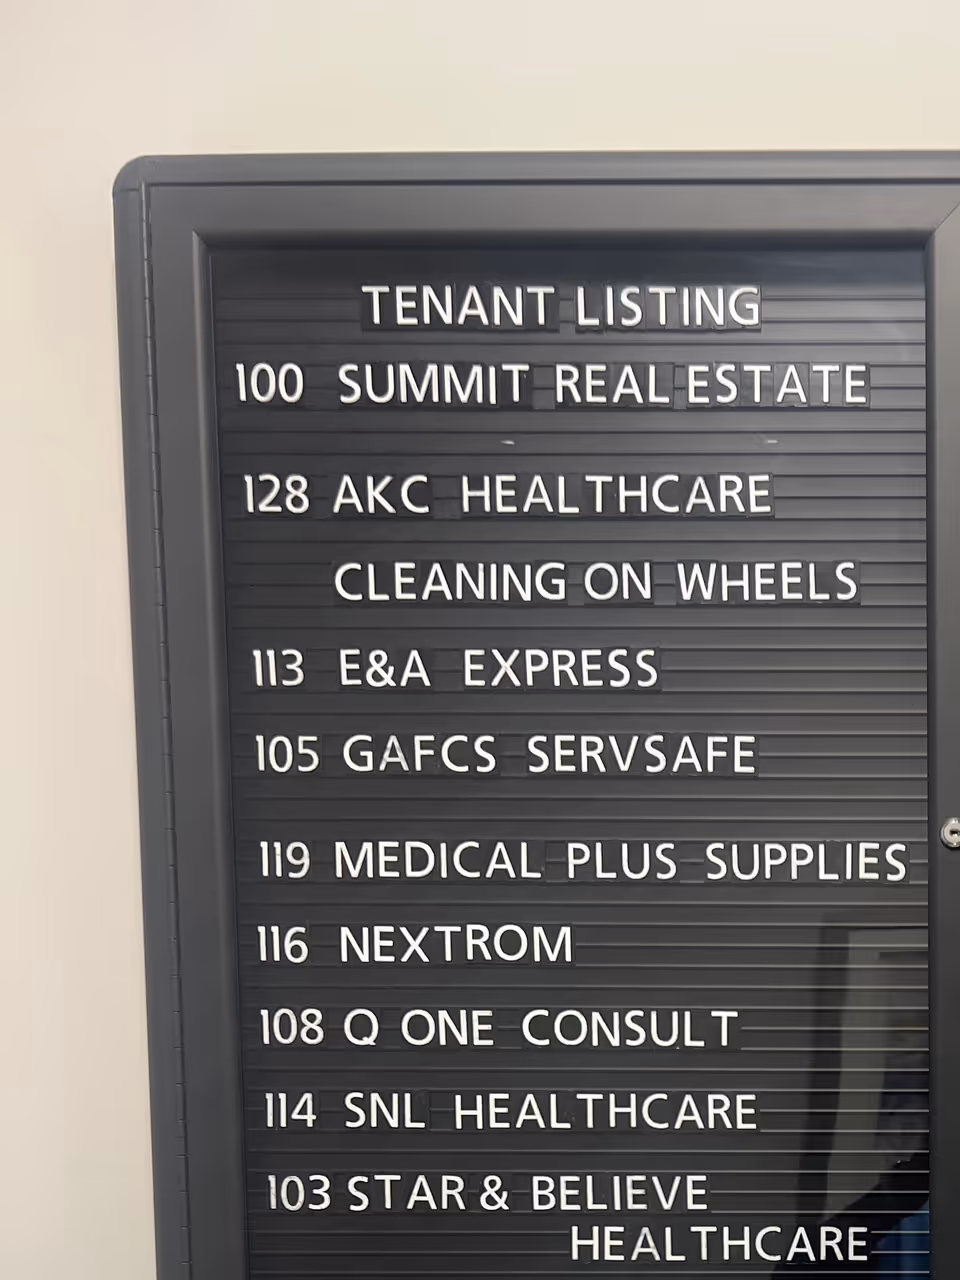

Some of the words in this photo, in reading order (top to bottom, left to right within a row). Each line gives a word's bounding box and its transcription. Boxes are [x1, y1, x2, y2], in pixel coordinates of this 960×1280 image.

[362, 286, 554, 325] TENANT
[577, 286, 760, 327] LISTING
[236, 363, 303, 402] 100
[339, 364, 529, 404] SUMMIT
[556, 364, 669, 403] REAL
[688, 364, 867, 404] ESTATE
[245, 474, 309, 513] 128
[334, 475, 429, 513] AKC
[463, 474, 771, 513] HEALTHCARE
[335, 562, 565, 601] CLEANING
[585, 562, 651, 600] ON
[678, 562, 856, 601] WHEELS
[253, 649, 303, 686] 113
[340, 649, 430, 687] E&A
[465, 649, 657, 687] EXPRESS
[256, 735, 319, 772] 105
[343, 735, 495, 772] GAFCS
[528, 735, 755, 773] SERVSAFE
[260, 841, 309, 878] 119
[335, 841, 541, 878] MEDICAL
[568, 842, 676, 879] PLUS
[706, 843, 905, 881] SUPPLIES
[258, 926, 308, 963] 116
[341, 924, 571, 962] NEXTROM
[261, 1009, 323, 1044] 108
[344, 1009, 378, 1045] Q
[402, 1010, 493, 1045] ONE
[523, 1010, 738, 1046] CONSULT
[266, 1093, 316, 1127] 114
[345, 1092, 425, 1128] SNL
[455, 1094, 756, 1129] HEALTHCARE
[269, 1175, 330, 1210] 103
[348, 1175, 465, 1211] STAR
[480, 1175, 509, 1210] &
[533, 1175, 707, 1210] BELIEVE
[572, 1226, 867, 1261] HEALTHCARE
